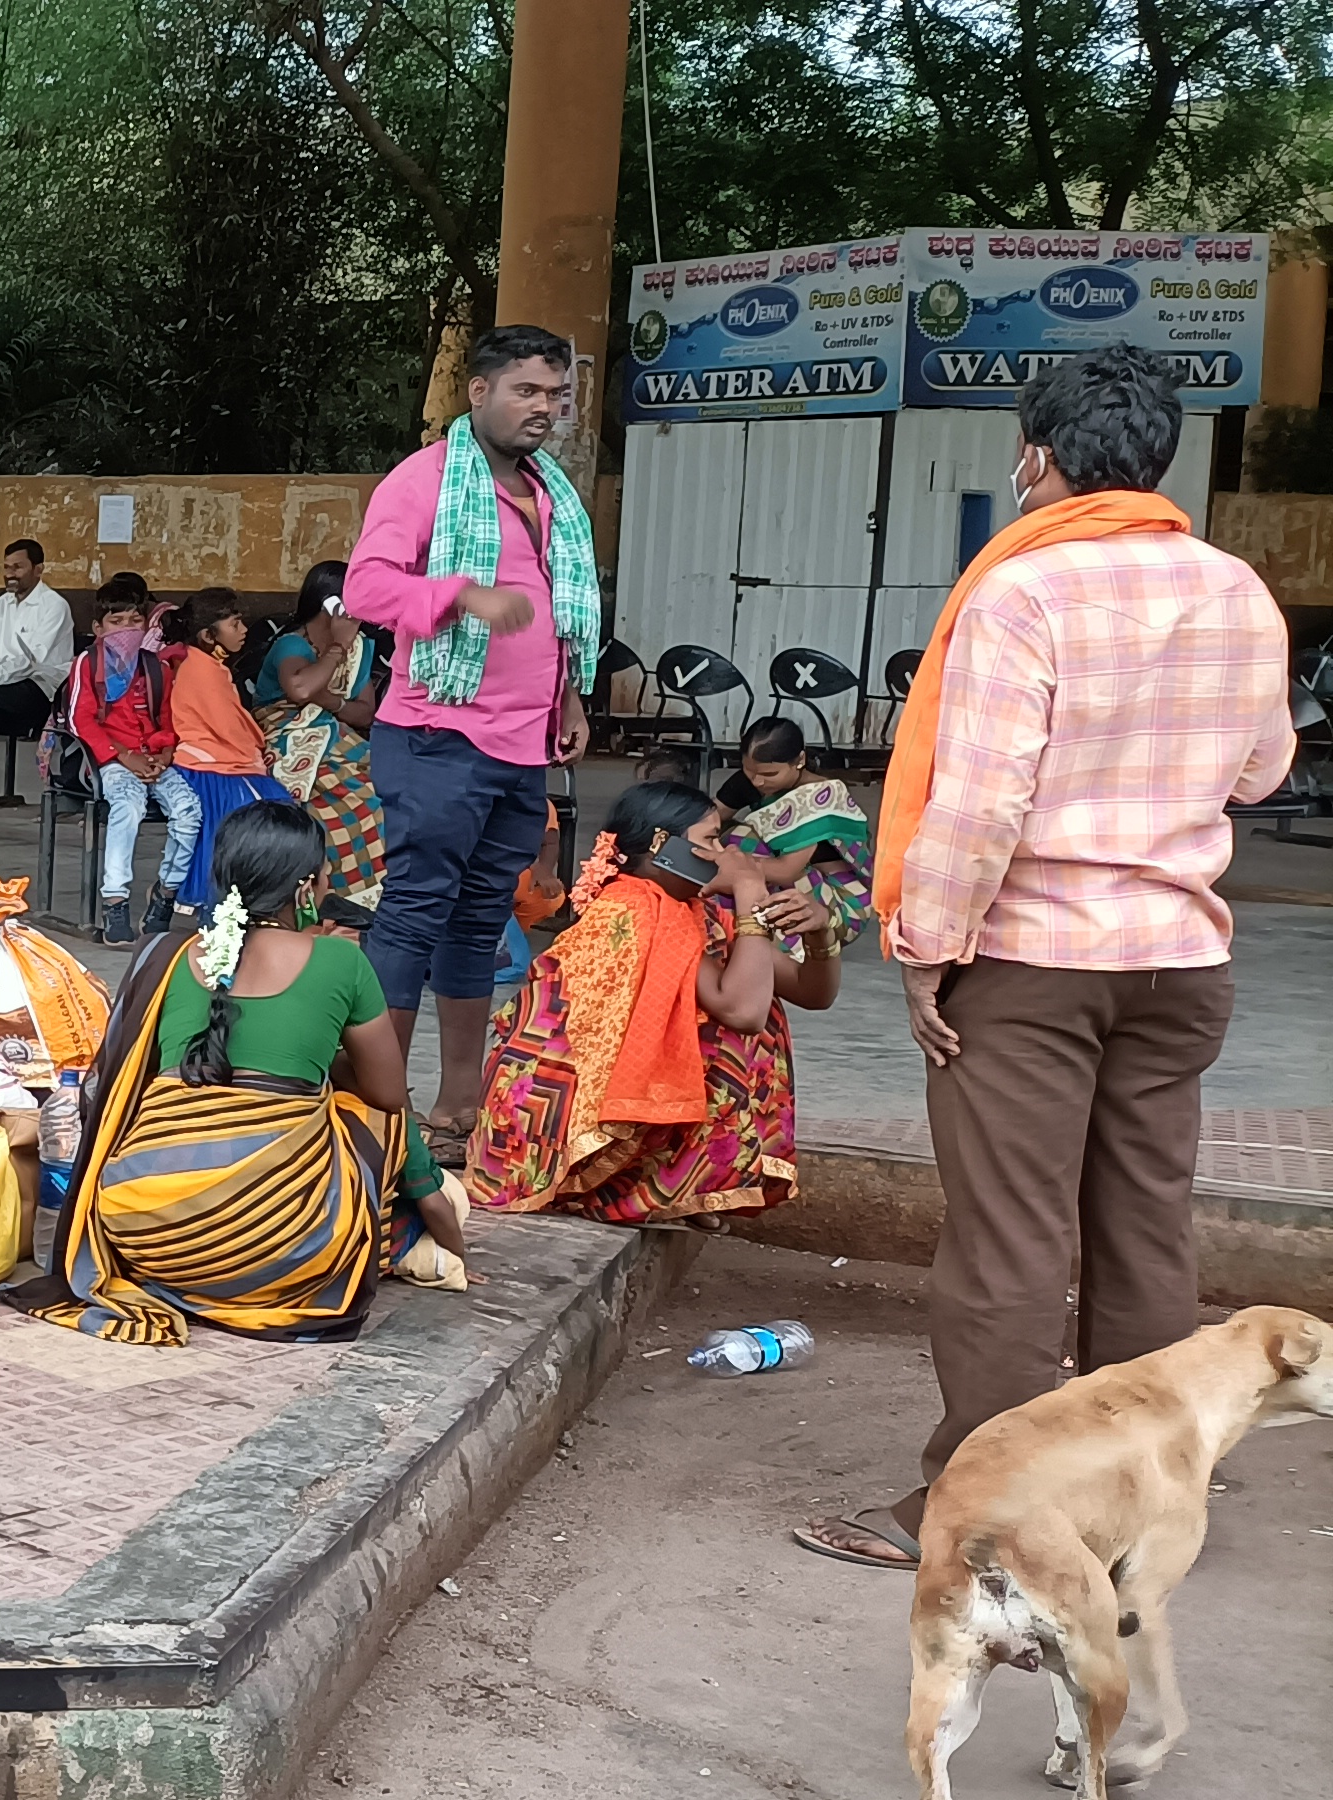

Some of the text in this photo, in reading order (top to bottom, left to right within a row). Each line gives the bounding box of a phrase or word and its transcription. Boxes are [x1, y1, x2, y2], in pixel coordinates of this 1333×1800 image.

[988, 231, 1101, 261] ಕುಡಿಯುವ
[1113, 234, 1182, 262] ನೀರಿನ
[1194, 236, 1254, 265] ಘಟಕ
[684, 255, 770, 287] ಕುಡಿಯುವ
[779, 250, 838, 277] ನೀರಿನ
[847, 240, 900, 273] ಘಟಕ
[809, 281, 904, 310] Pure & Cold
[1049, 279, 1126, 309] PHOENIX
[1151, 279, 1257, 299] Pure & Cold
[727, 298, 789, 328] PHOENIX
[841, 317, 858, 331] UV
[1189, 310, 1208, 323] UV
[823, 335, 879, 350] Controller
[1168, 328, 1232, 341] Controller
[644, 360, 876, 403] WATER ATM
[938, 353, 1230, 384] WAT TM
